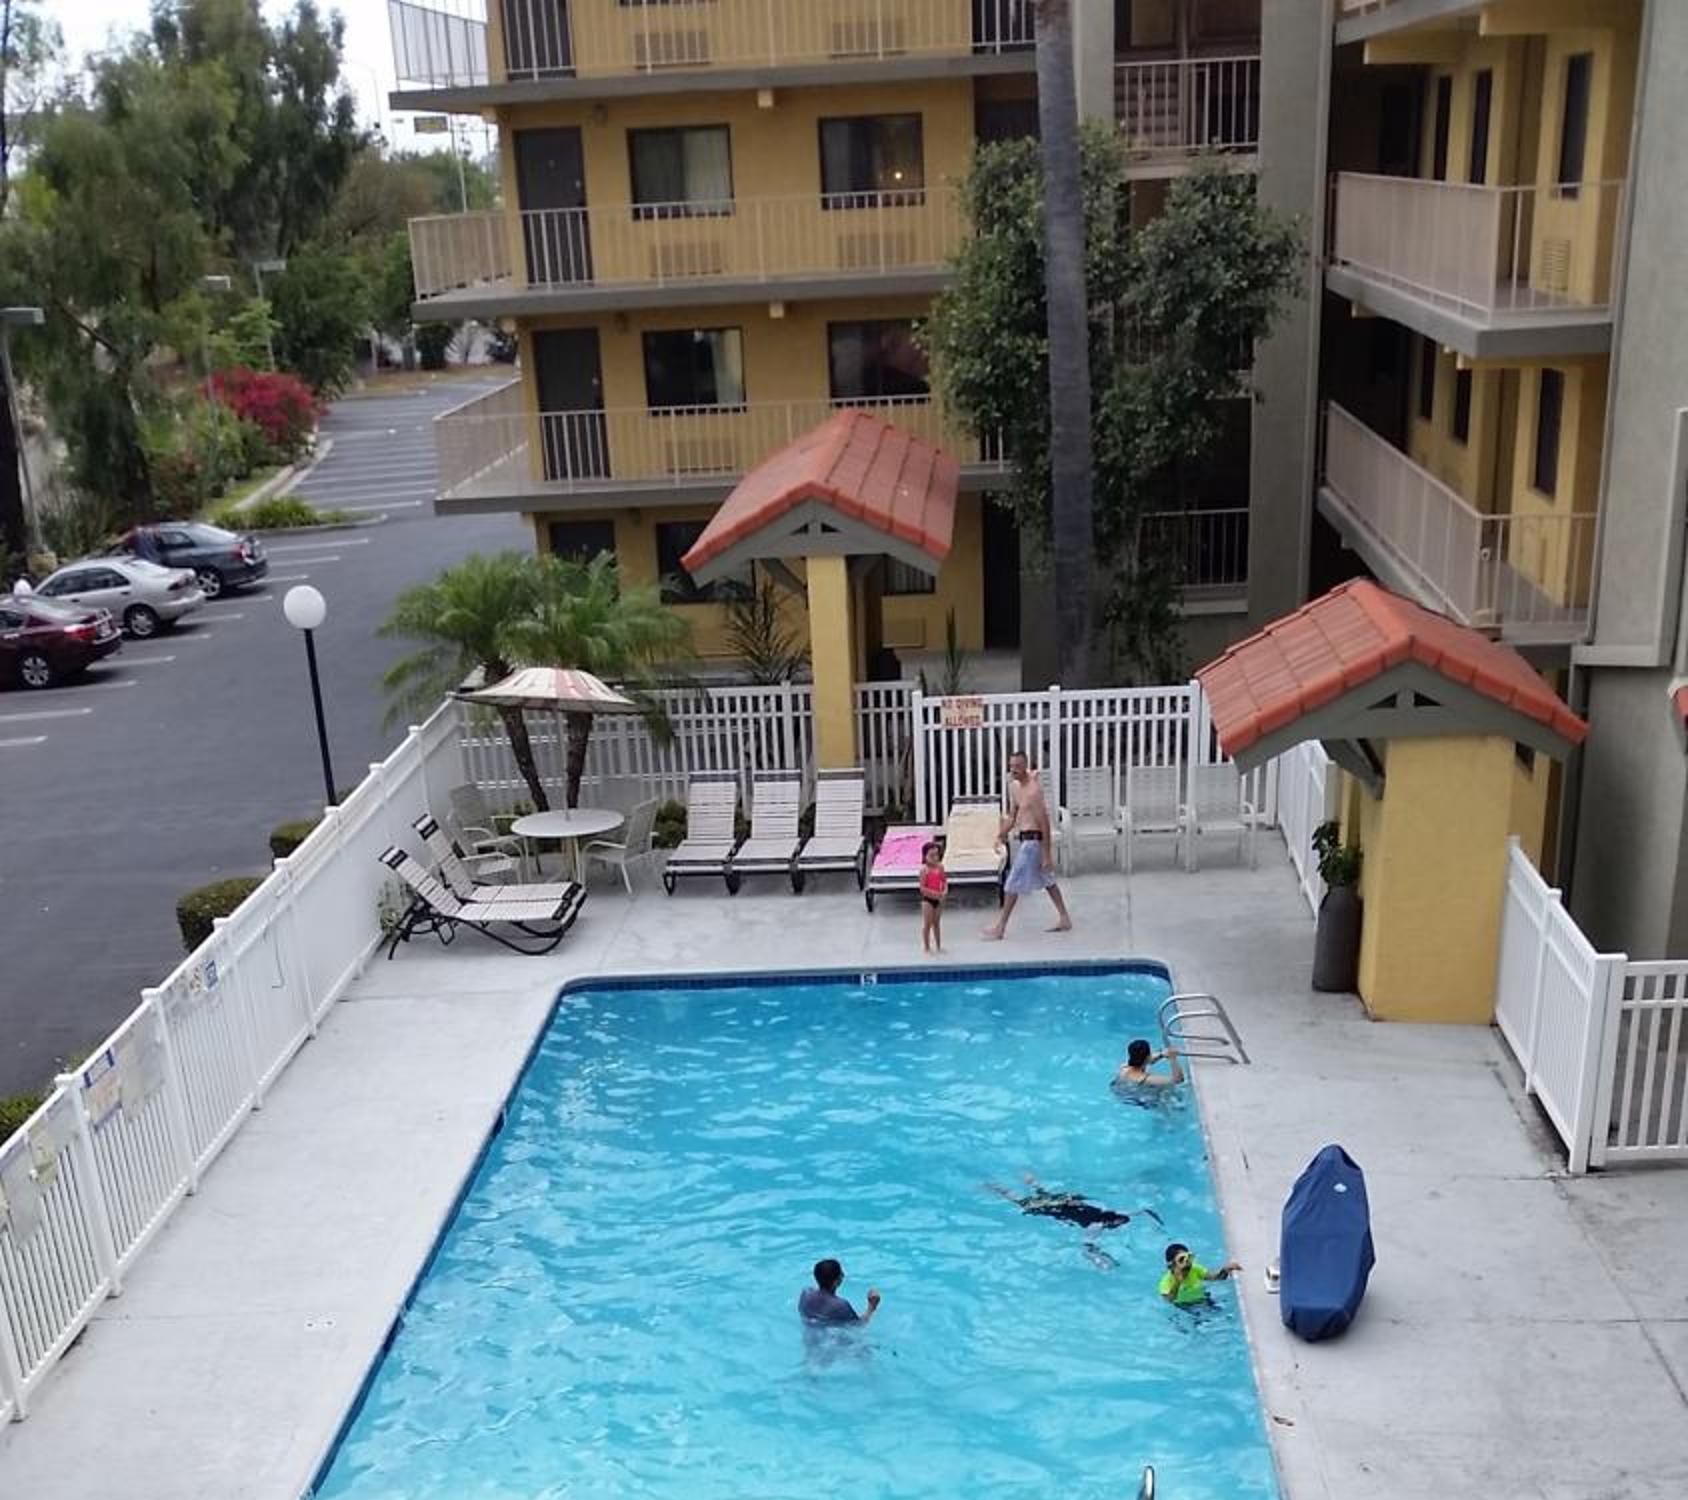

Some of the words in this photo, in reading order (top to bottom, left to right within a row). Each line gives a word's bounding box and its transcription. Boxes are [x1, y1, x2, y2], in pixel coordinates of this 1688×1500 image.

[941, 698, 954, 709] NO
[955, 698, 983, 709] DIVING
[944, 714, 981, 726] ALLOWED
